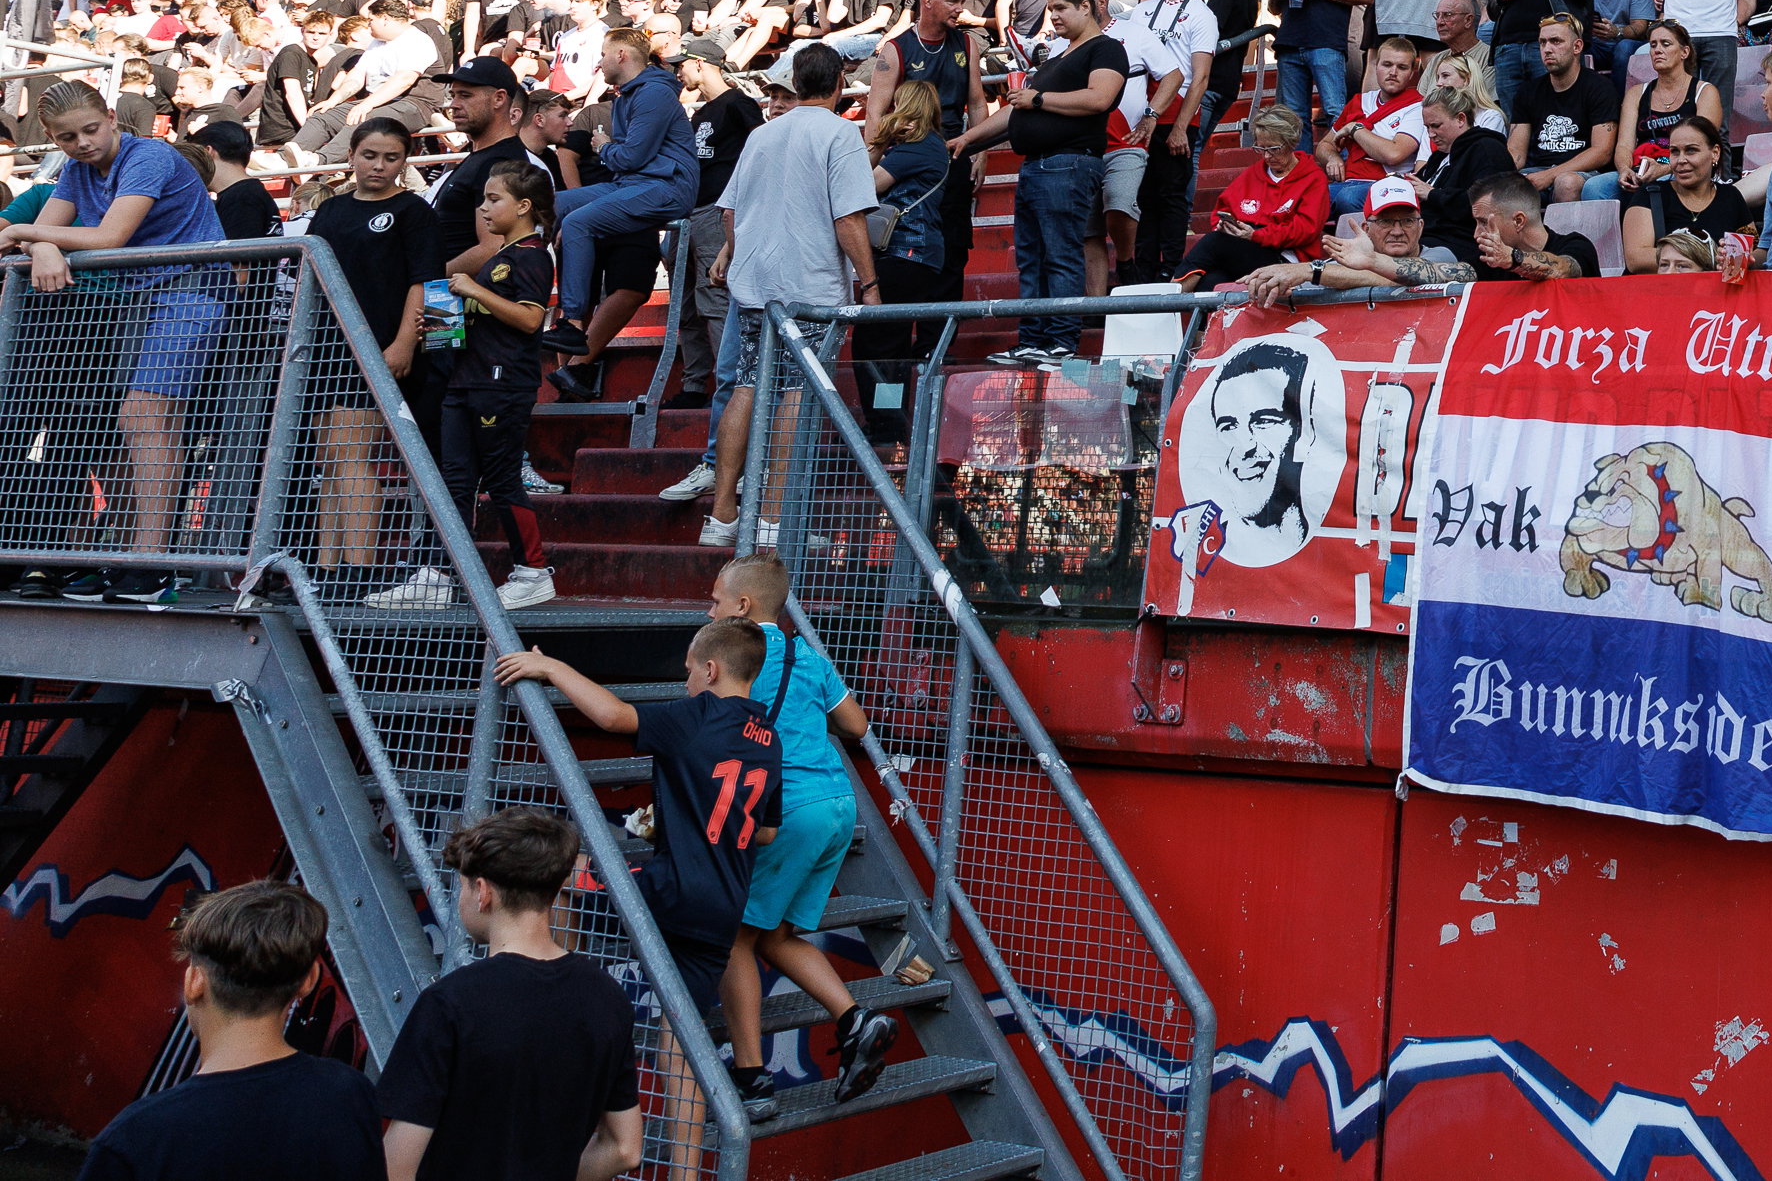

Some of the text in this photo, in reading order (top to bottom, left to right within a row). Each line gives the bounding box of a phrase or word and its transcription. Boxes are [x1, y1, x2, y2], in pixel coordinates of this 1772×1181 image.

[1480, 308, 1653, 385] Forza
[1203, 536, 1218, 556] C
[1432, 478, 1542, 553] Vak
[708, 759, 768, 850] 11
